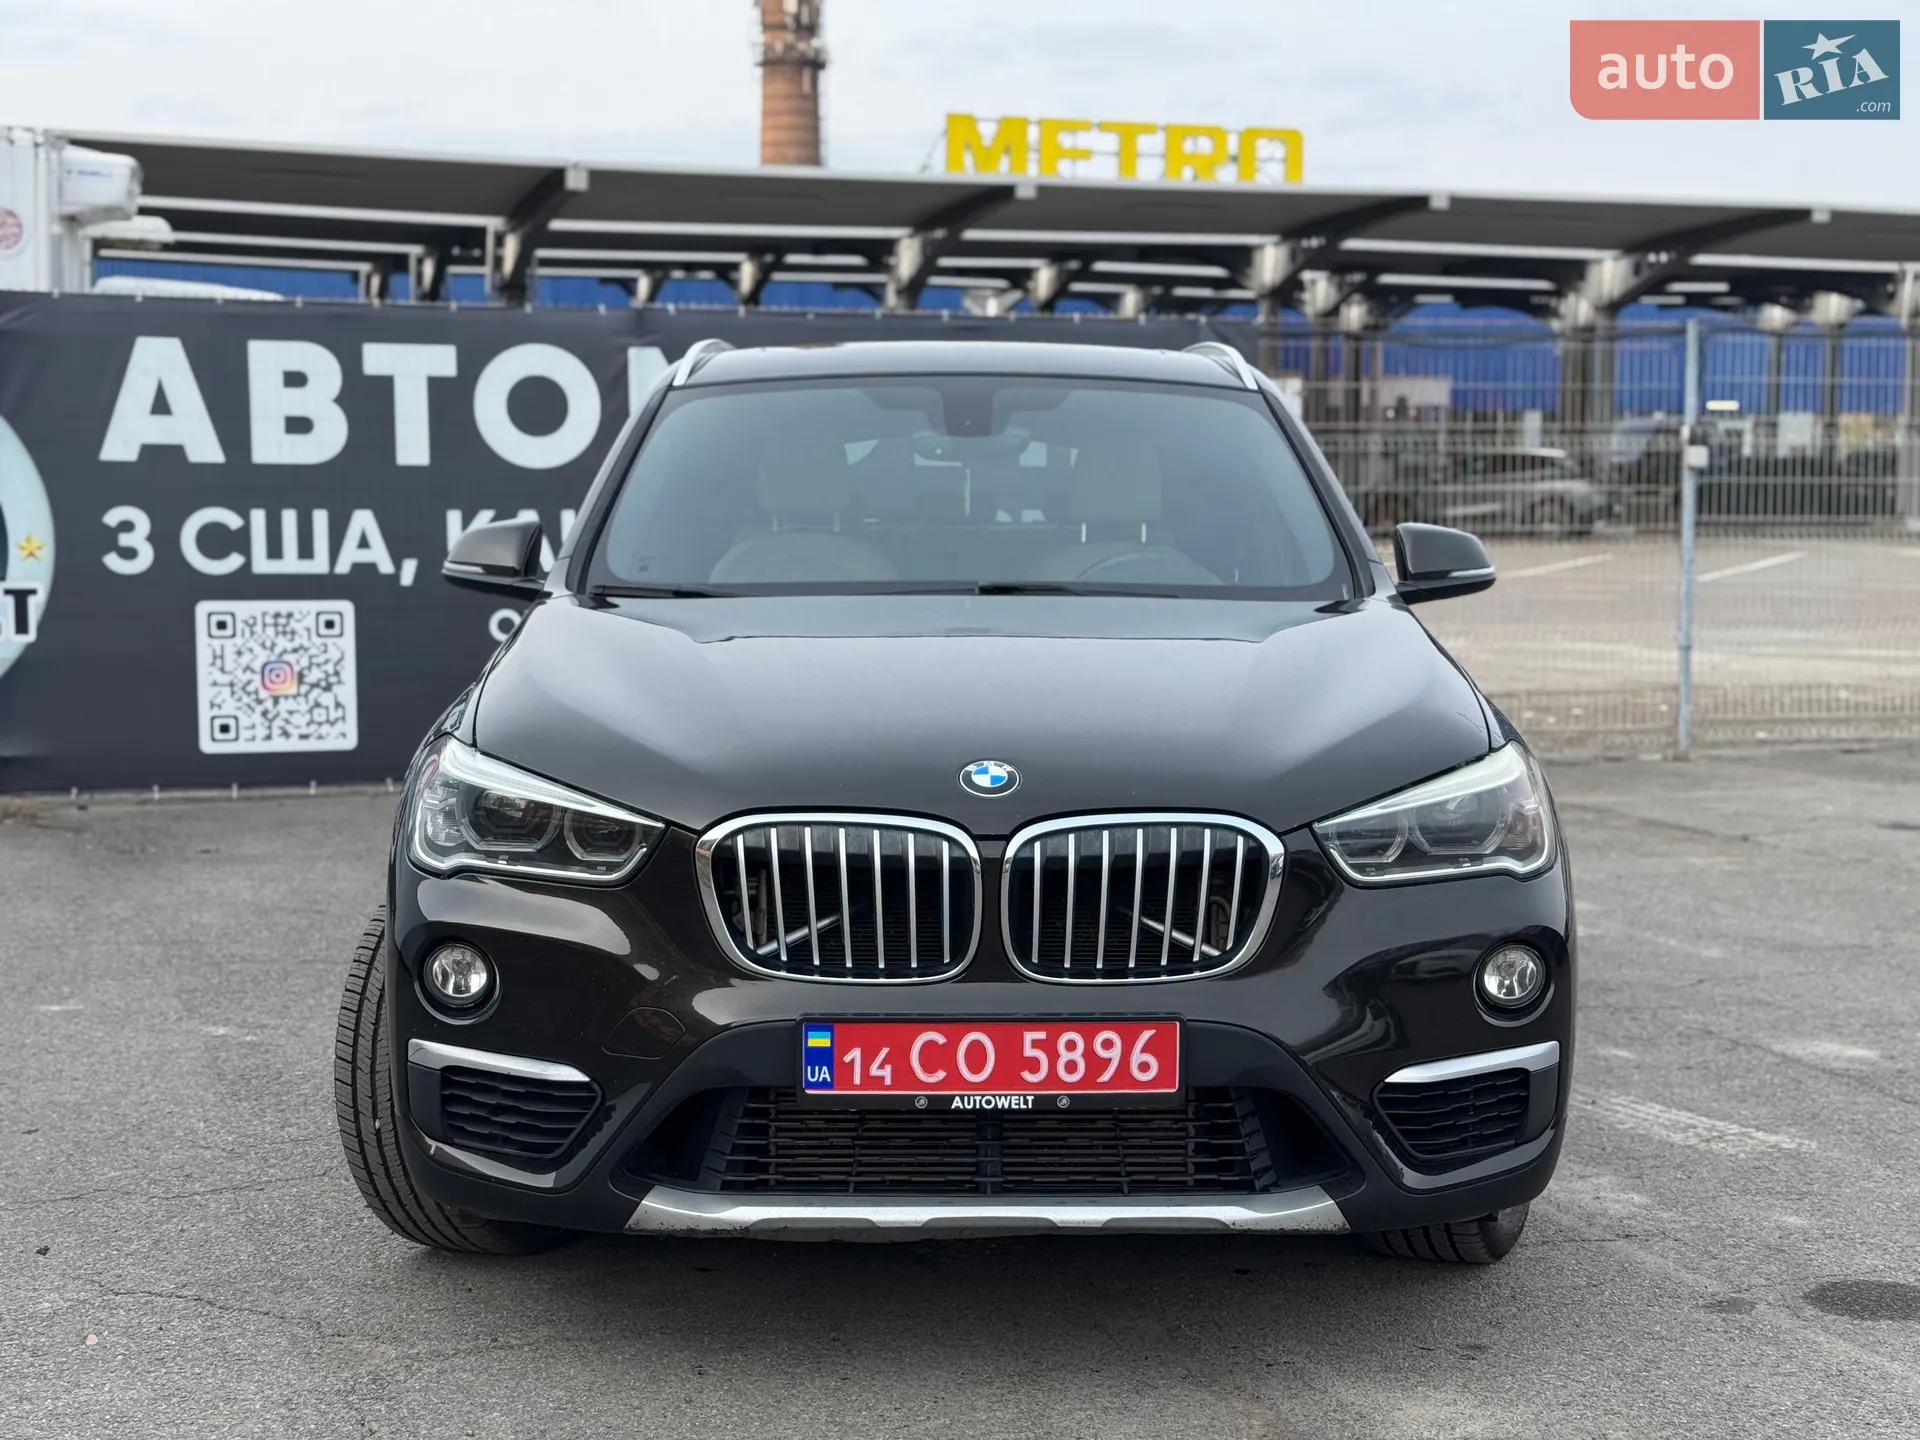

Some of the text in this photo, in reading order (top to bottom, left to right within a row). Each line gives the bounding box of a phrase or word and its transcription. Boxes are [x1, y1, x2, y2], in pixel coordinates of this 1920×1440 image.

[945, 113, 1304, 185] METRO
[179, 507, 418, 587] США,
[807, 1030, 1160, 1086] UA 14 CO 5896
[950, 1095, 1035, 1109] AUTOWELT
